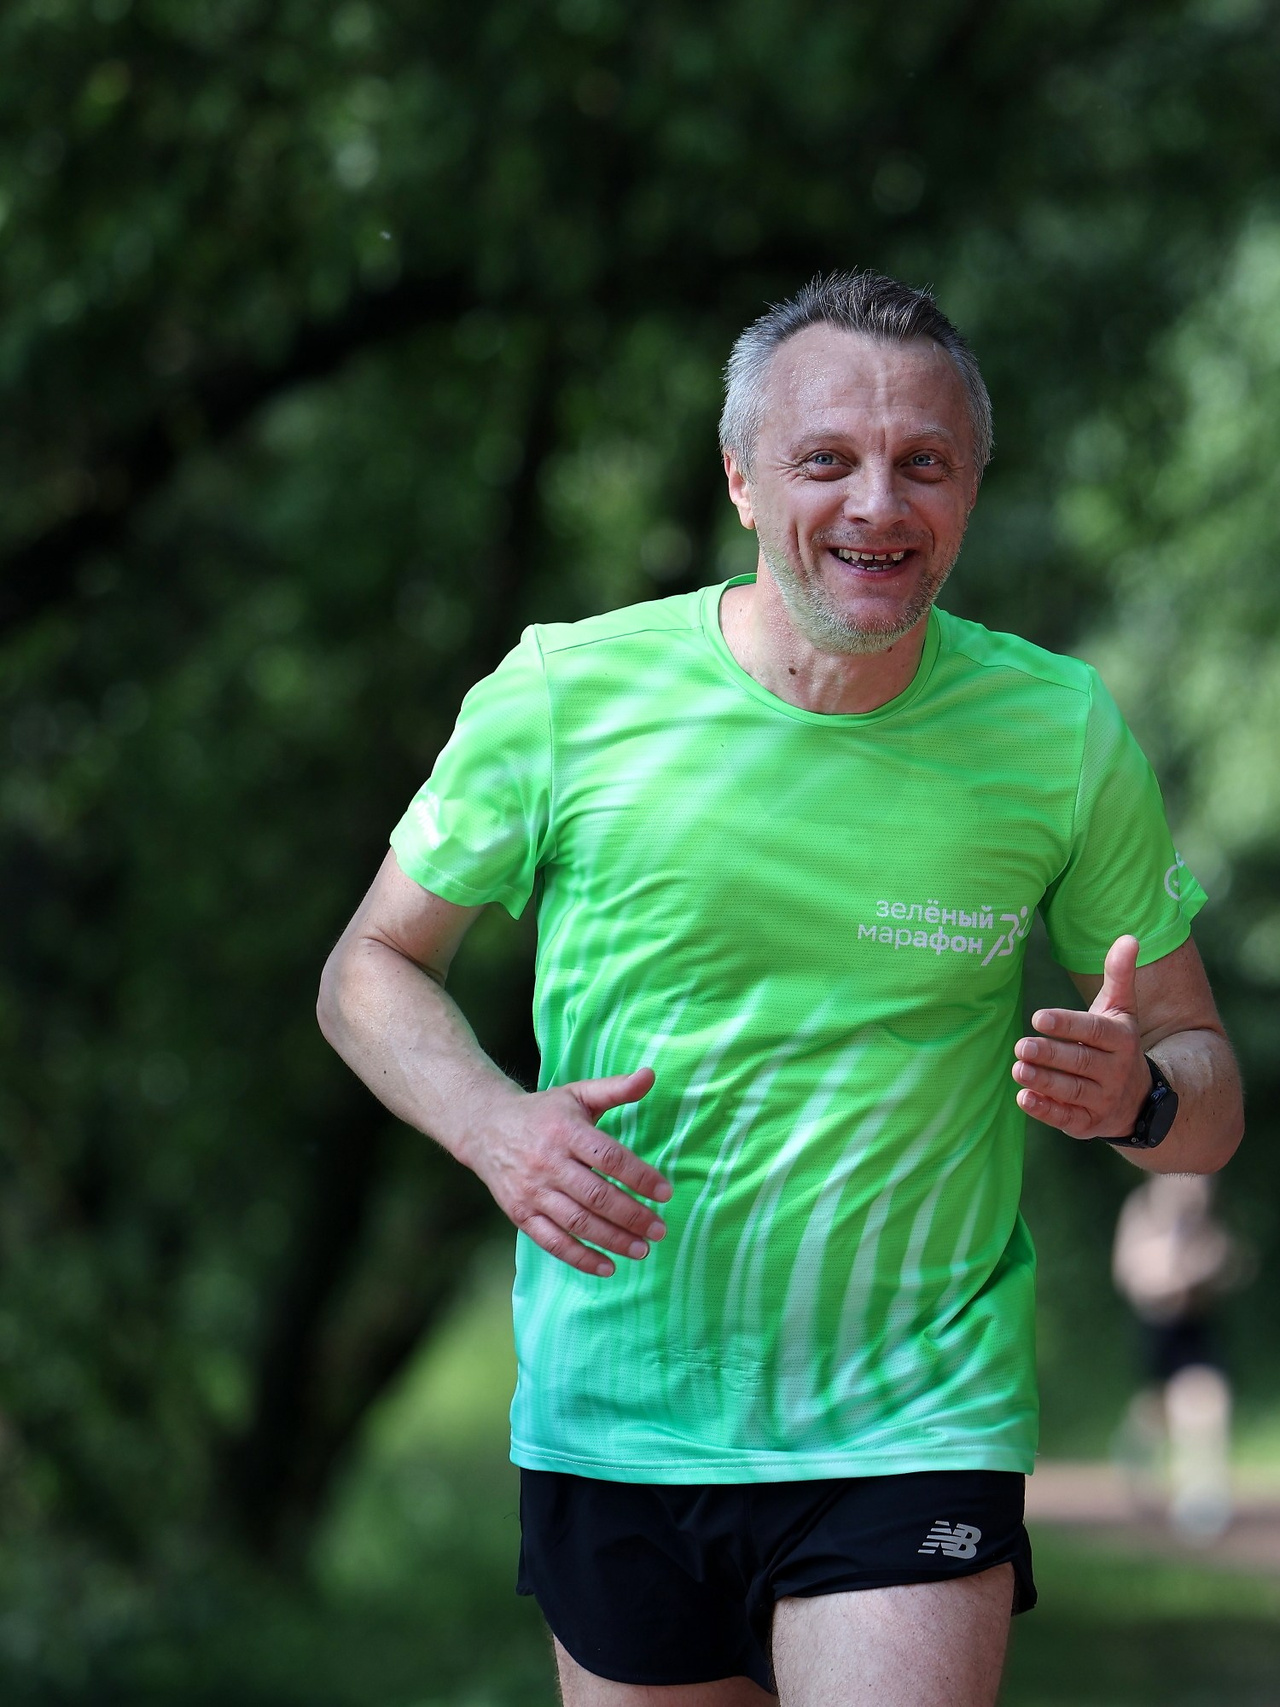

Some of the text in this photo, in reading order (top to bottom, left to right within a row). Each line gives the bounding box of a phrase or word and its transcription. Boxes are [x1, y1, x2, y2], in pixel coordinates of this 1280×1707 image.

[876, 899, 993, 929] зелёный
[857, 924, 983, 955] марафон
[917, 1520, 982, 1559] NB
